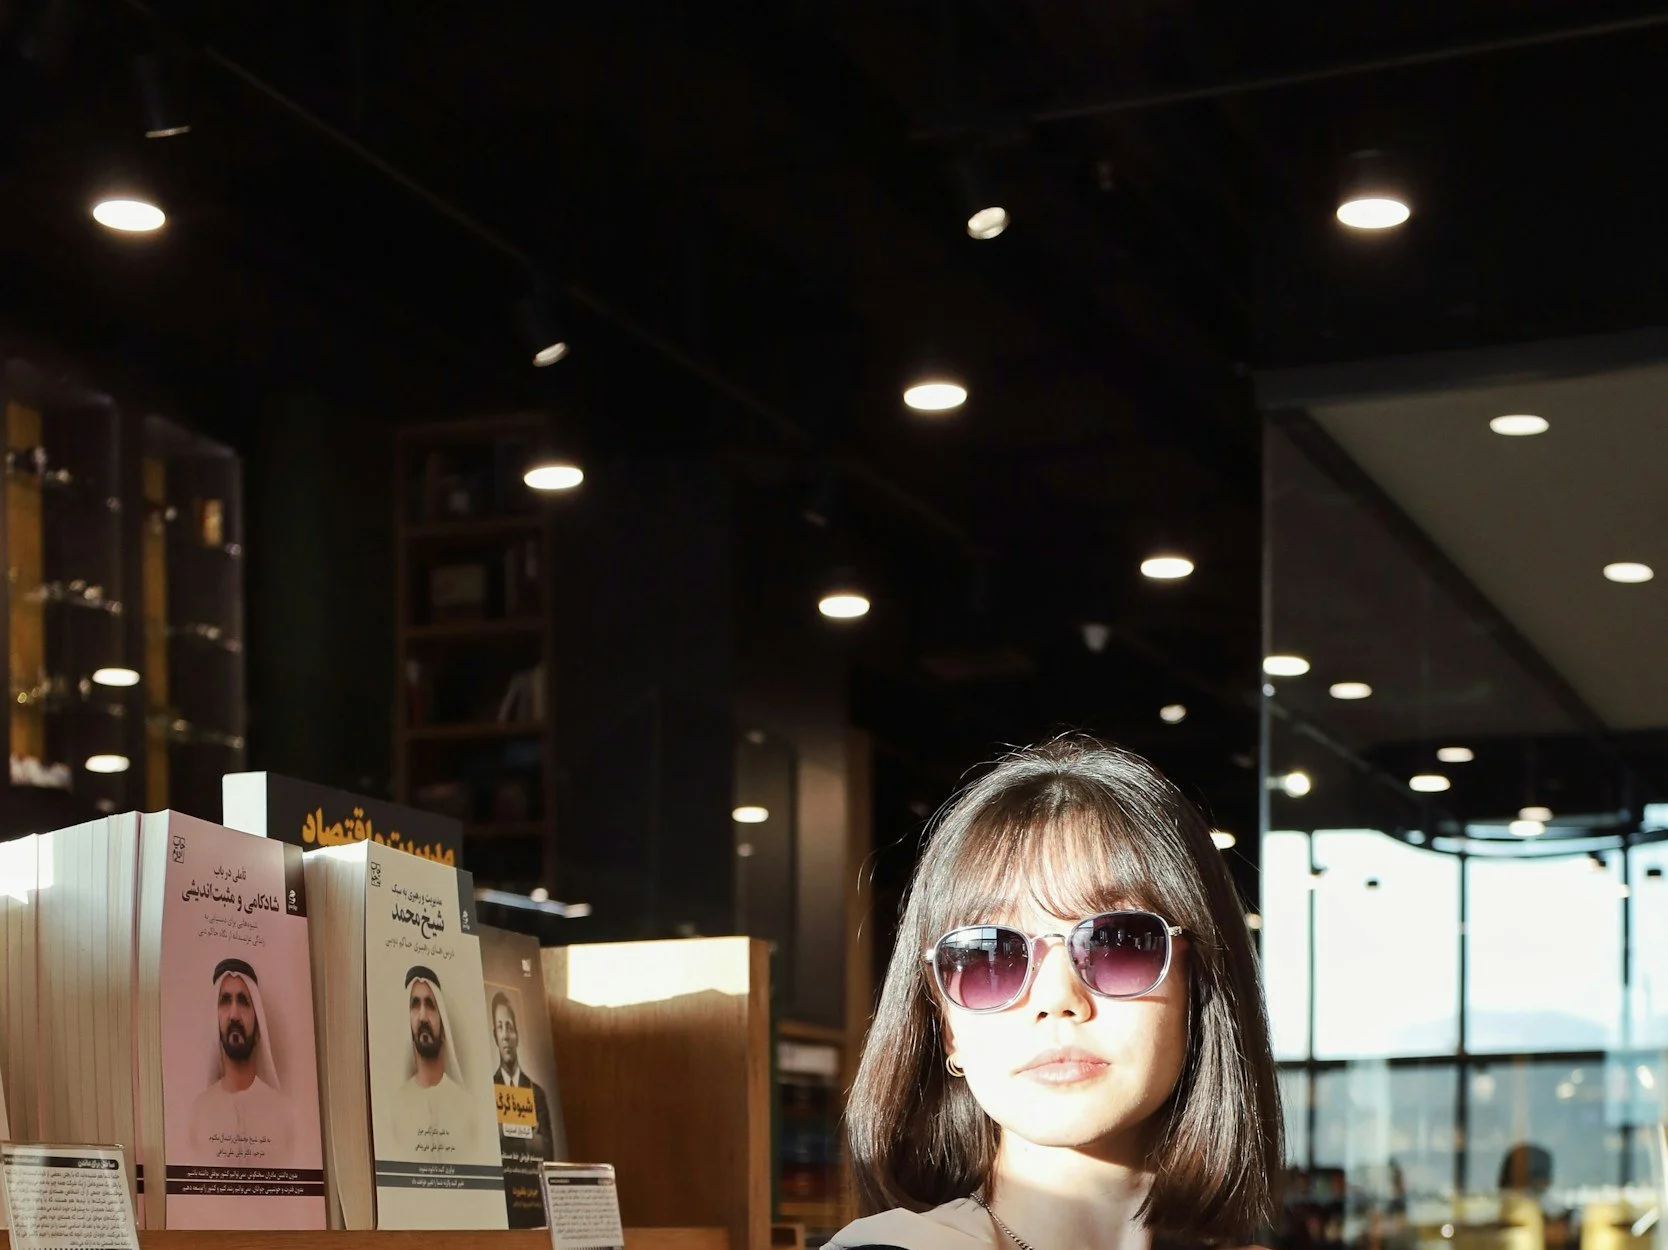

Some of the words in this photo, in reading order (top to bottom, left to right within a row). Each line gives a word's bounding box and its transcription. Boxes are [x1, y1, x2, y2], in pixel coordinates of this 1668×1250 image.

[302, 806, 372, 847] اقتصاد
[214, 866, 223, 879] باب
[225, 869, 231, 880] در
[392, 884, 401, 897] سبک
[403, 888, 407, 899] به
[237, 895, 242, 911] و
[244, 893, 280, 914] شادکامی
[408, 892, 421, 904] رهبری
[425, 895, 442, 907] مدیریت
[392, 903, 420, 926] محمد
[421, 908, 444, 939] شیخ
